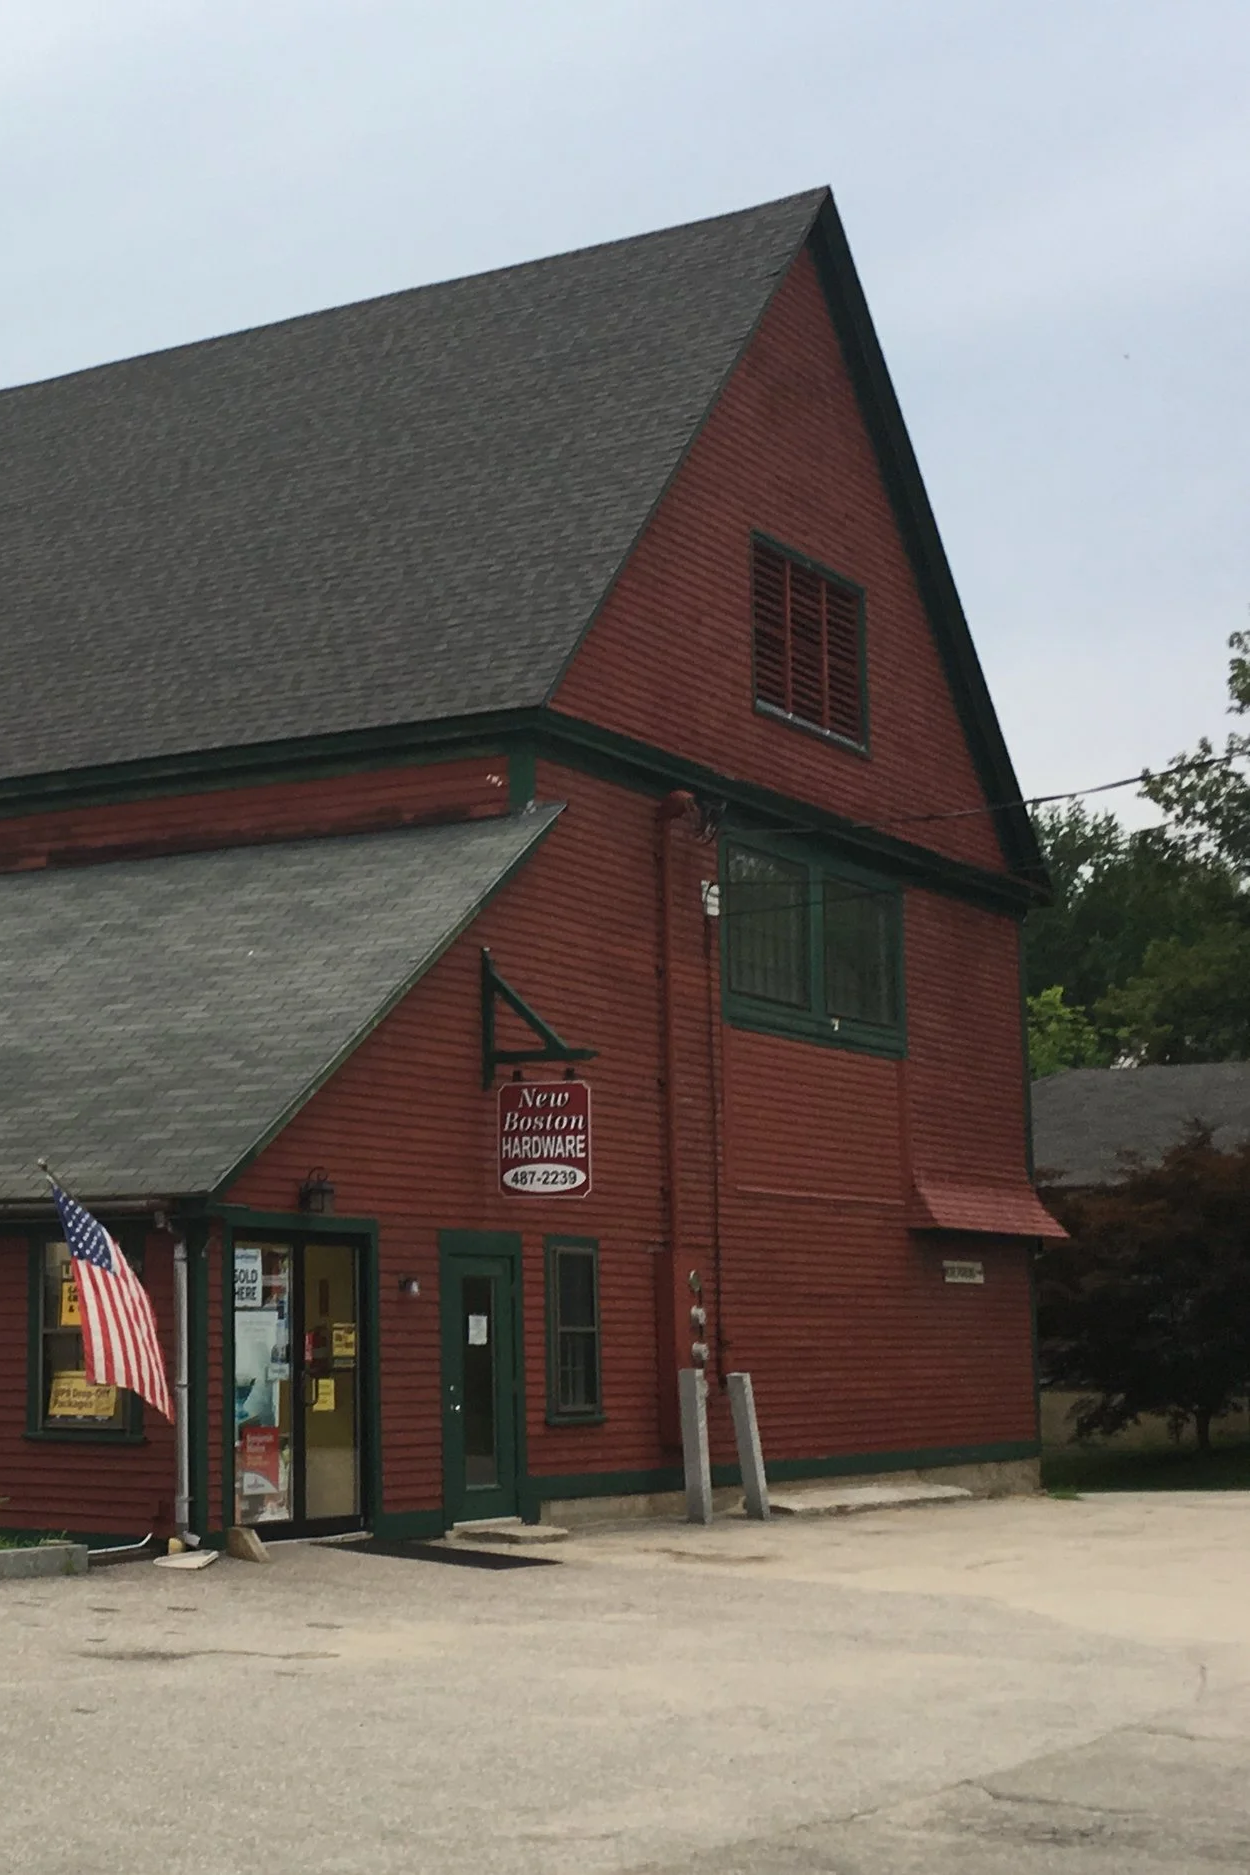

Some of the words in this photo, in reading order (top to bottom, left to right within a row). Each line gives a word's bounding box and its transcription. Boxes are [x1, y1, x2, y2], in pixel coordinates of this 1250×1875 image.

[518, 1088, 570, 1109] New
[503, 1111, 586, 1132] Boston
[502, 1135, 586, 1160] HARDWARE
[511, 1170, 578, 1186] 487-2239
[234, 1268, 258, 1284] SOLD
[234, 1286, 257, 1301] HERE
